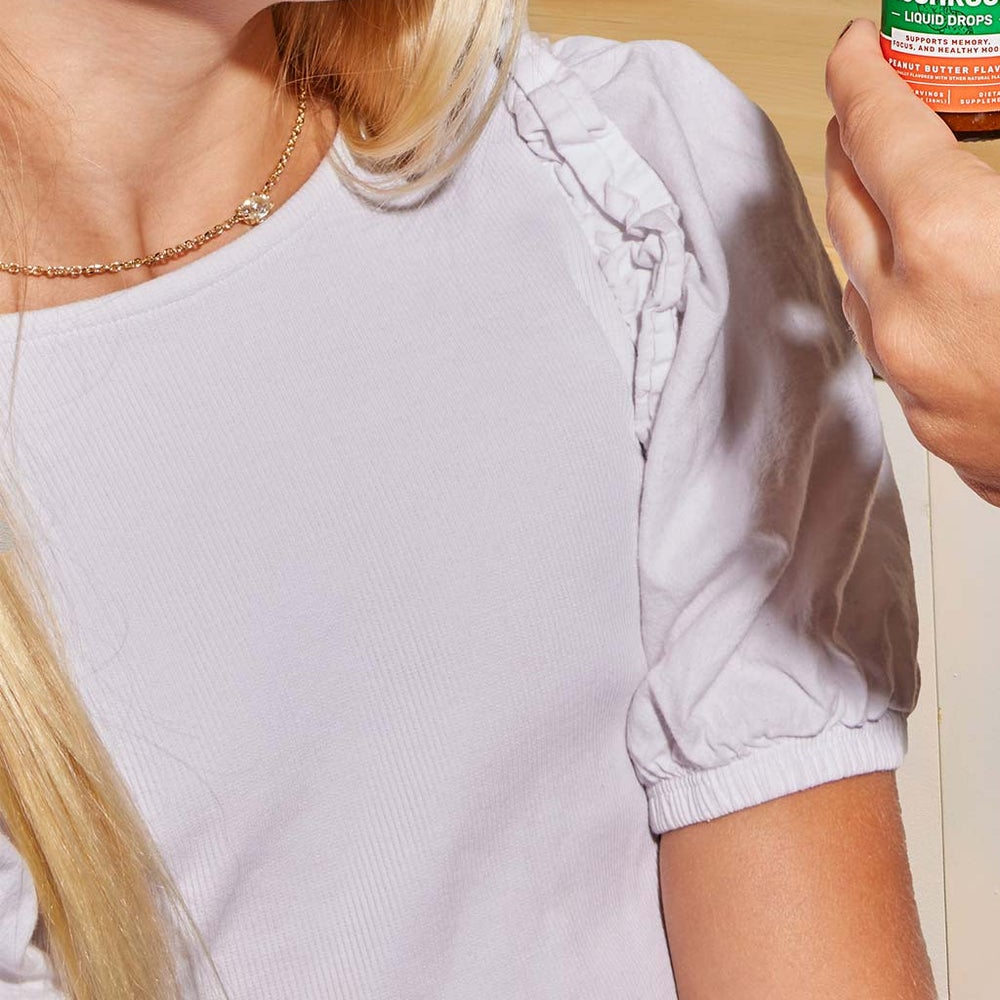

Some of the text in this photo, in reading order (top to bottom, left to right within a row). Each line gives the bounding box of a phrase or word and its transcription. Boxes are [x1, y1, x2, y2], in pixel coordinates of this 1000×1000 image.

[904, 10, 993, 26] LIQUID DROPS
[892, 39, 916, 51] FOCUS,
[938, 46, 979, 54] HEALTHY
[905, 35, 948, 45] SUPPORTS
[888, 57, 921, 72] PEANUT
[924, 64, 970, 75] BUTTER
